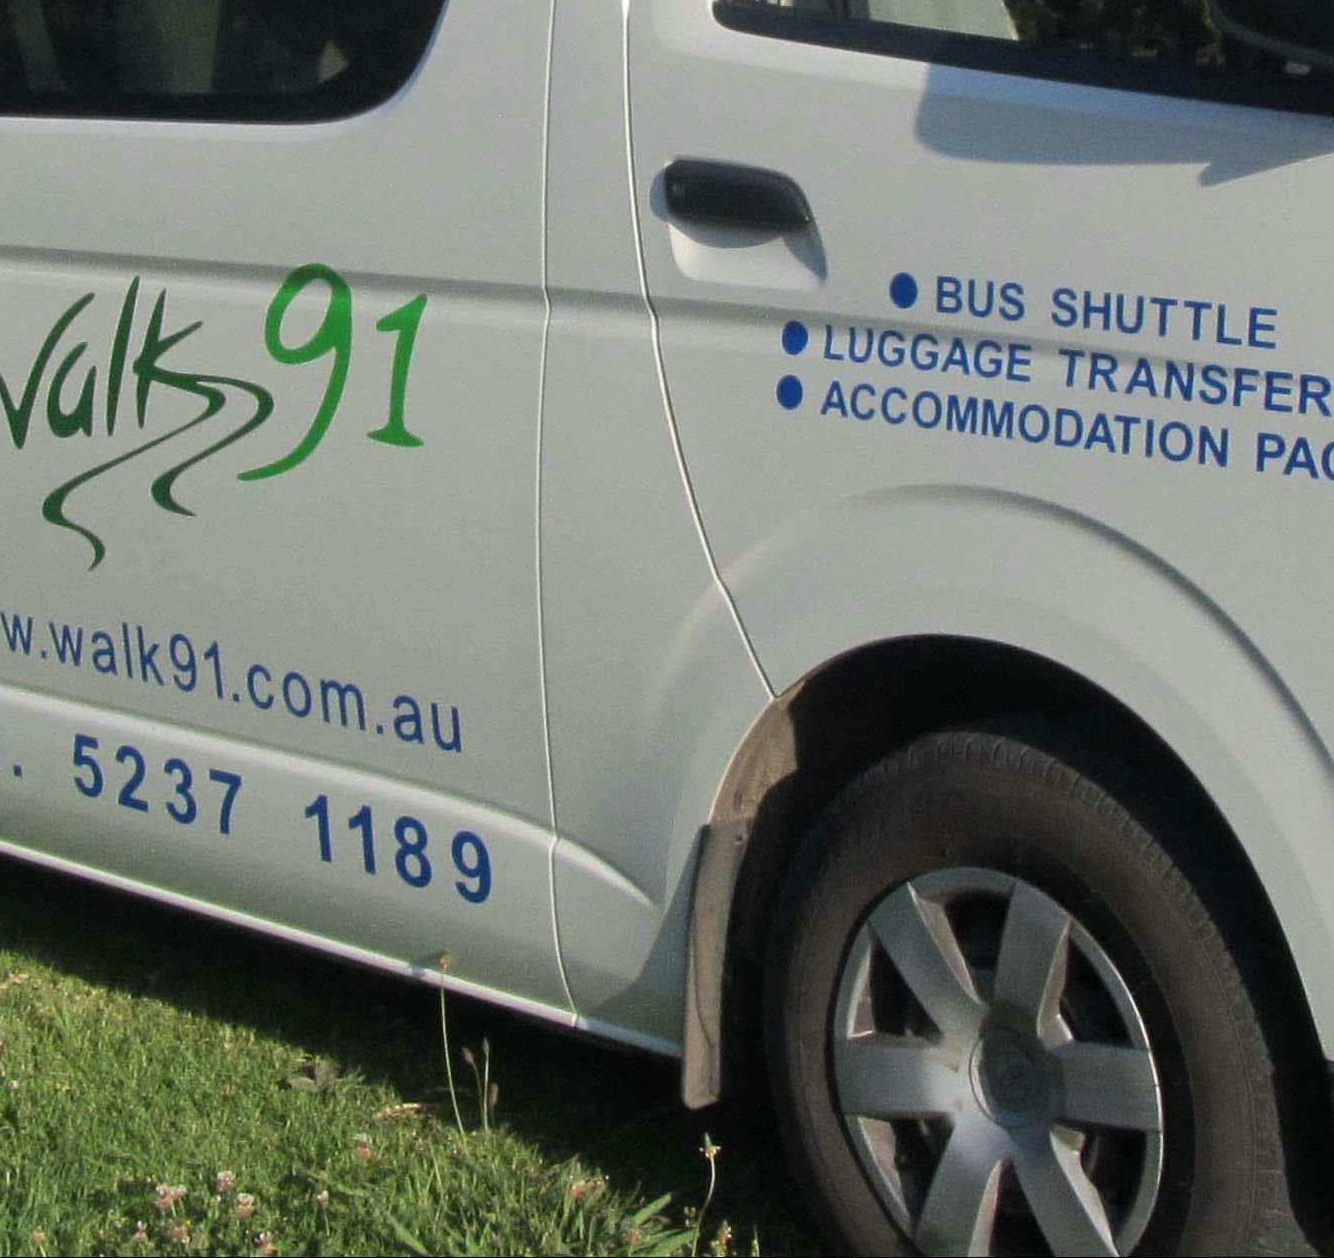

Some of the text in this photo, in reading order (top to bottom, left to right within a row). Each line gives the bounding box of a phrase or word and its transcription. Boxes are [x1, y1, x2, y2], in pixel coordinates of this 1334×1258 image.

[823, 324, 1033, 383] LUGGAGE
[935, 275, 1279, 350] BUS SHUTTLE
[820, 380, 1230, 469] ACCOMMODATION
[72, 733, 243, 837] 5237
[303, 793, 493, 906] 1189
